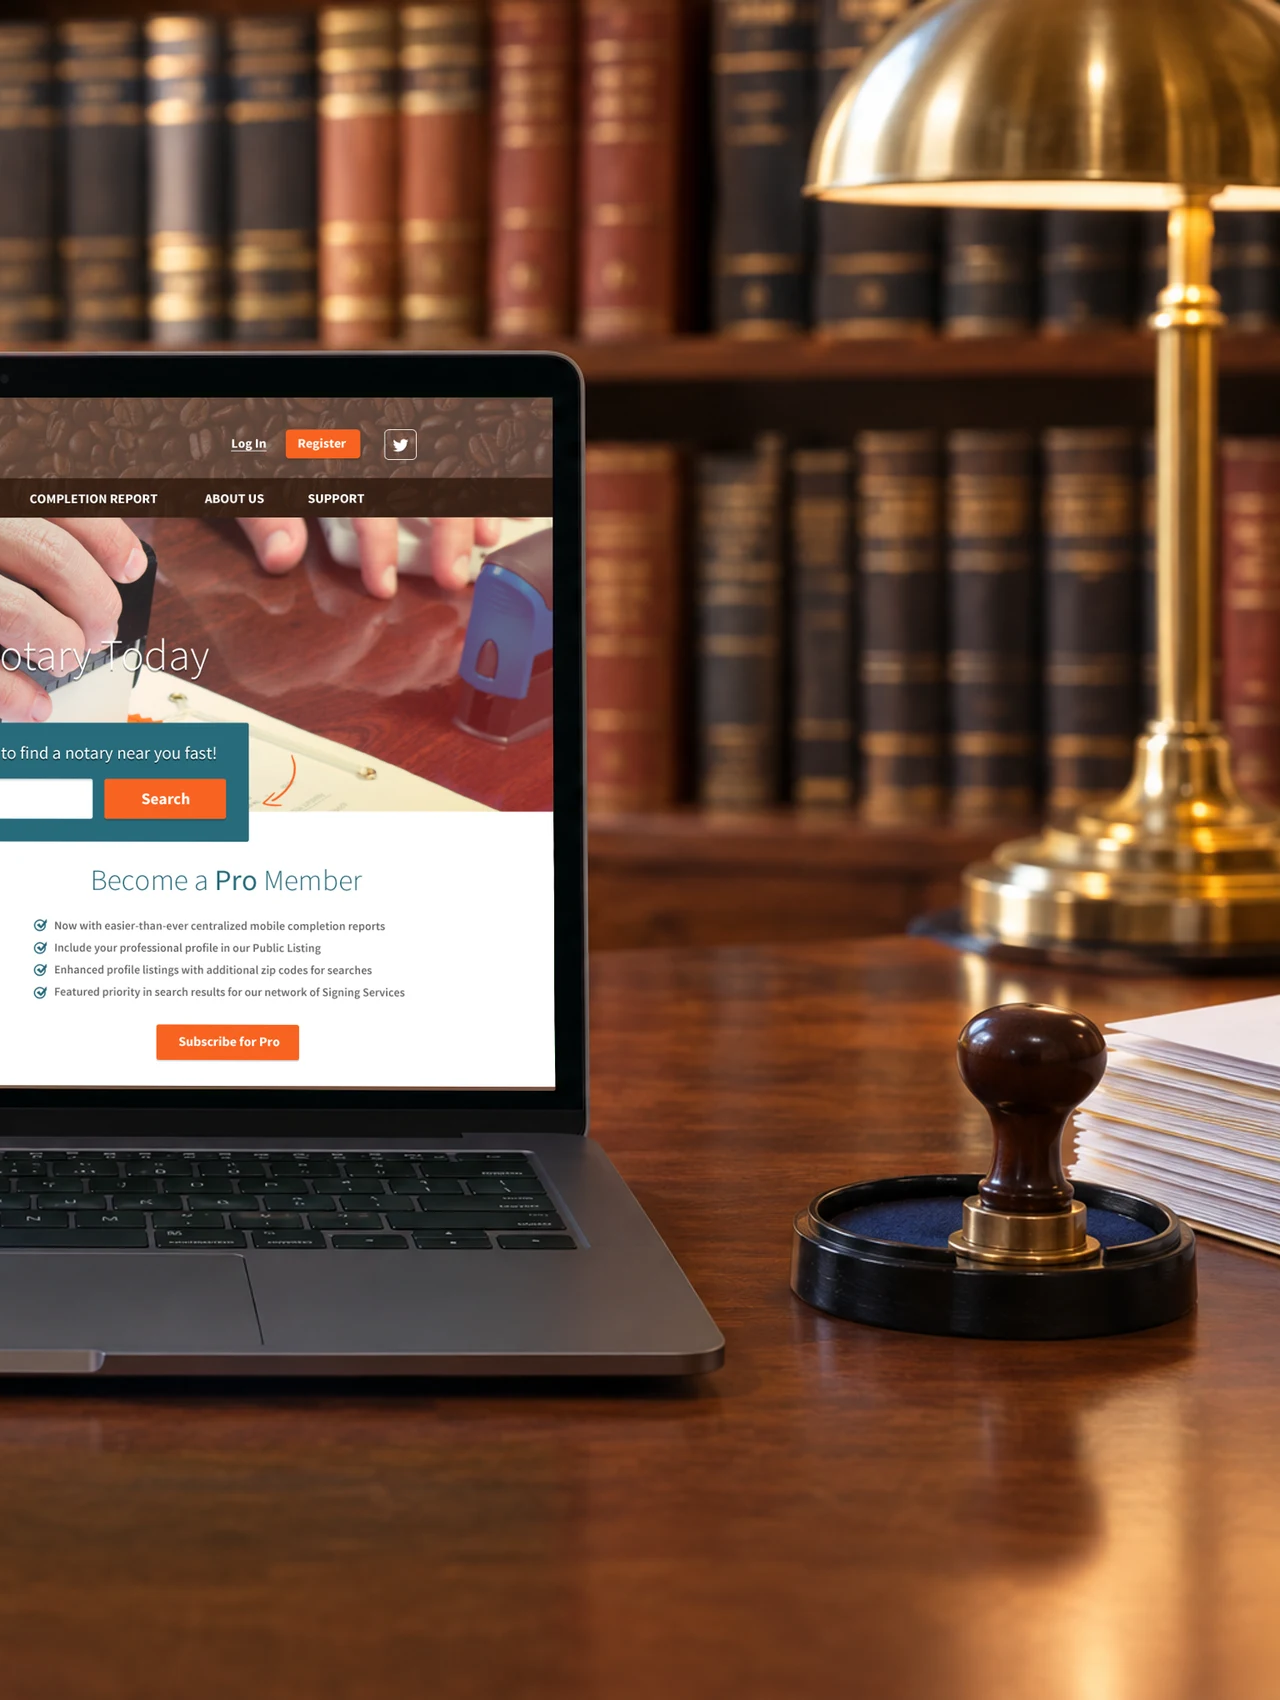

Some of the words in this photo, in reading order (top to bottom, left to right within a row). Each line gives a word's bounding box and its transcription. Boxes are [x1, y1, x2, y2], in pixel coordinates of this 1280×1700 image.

[231, 438, 252, 452] Log
[254, 437, 268, 450] In
[298, 438, 346, 451] Register
[29, 493, 107, 505] COMPLETION
[110, 493, 158, 504] REPORT
[204, 493, 246, 504] ABOUT
[248, 493, 265, 504] US
[307, 493, 365, 504] SUPPORT
[101, 638, 209, 681] Today
[0, 747, 17, 761] to
[20, 746, 48, 760] find
[52, 749, 61, 761] a
[66, 748, 113, 763] notary
[117, 749, 151, 760] near
[154, 750, 180, 763] you
[185, 746, 216, 759] fast!
[142, 792, 190, 805] Search
[93, 870, 187, 891] Become
[196, 875, 207, 891] a
[217, 870, 256, 891] Pro
[266, 869, 362, 891] Member
[54, 920, 78, 931] Now
[79, 920, 103, 931] with
[104, 920, 189, 931] easier-than-ever
[190, 920, 248, 931] centralized
[249, 920, 286, 931] mobile
[287, 920, 346, 933] completion
[348, 922, 386, 933] reports
[54, 942, 92, 953] Include
[93, 944, 118, 955] your
[119, 942, 183, 955] professional
[184, 942, 219, 955] profile
[220, 942, 231, 953] in
[232, 945, 251, 953] our
[252, 942, 285, 953] Public
[287, 942, 322, 956] Listing
[54, 964, 105, 975] Enhanced
[106, 964, 141, 977] profile
[142, 964, 180, 978] listings
[180, 964, 204, 975] with
[206, 964, 259, 975] additional
[260, 964, 277, 977] zip
[278, 964, 309, 976] codes
[310, 964, 326, 976] for
[327, 965, 373, 976] searches
[54, 986, 100, 997] Featured
[102, 986, 141, 1000] priority
[142, 986, 153, 997] in
[154, 986, 189, 997] search
[190, 986, 226, 997] results
[227, 986, 243, 997] for
[244, 989, 263, 997] our
[264, 986, 308, 998] network
[309, 986, 321, 998] of
[322, 987, 361, 1000] Signing
[362, 987, 406, 998] Services
[178, 1035, 238, 1047] Subscribe
[238, 1035, 258, 1047] for
[259, 1036, 281, 1048] Pro
